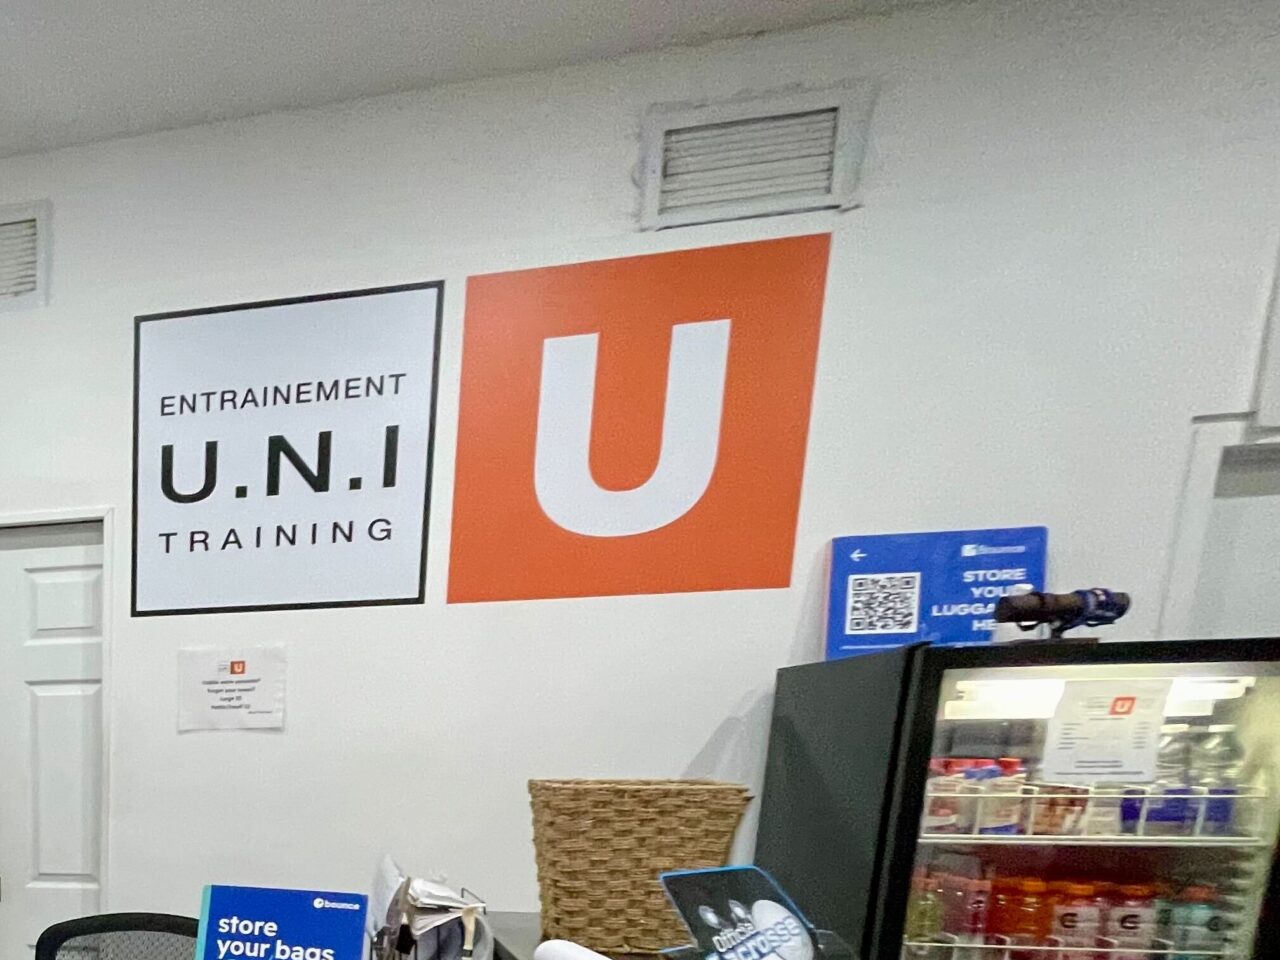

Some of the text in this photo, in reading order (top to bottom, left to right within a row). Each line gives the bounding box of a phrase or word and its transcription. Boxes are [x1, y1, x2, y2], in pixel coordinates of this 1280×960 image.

[160, 373, 407, 417] ENTRAINEMENT
[534, 318, 732, 538] U
[160, 425, 400, 504] U.N.I
[159, 518, 394, 554] TRAINING
[963, 568, 1027, 582] STORE
[971, 586, 1019, 598] YOU
[931, 603, 995, 616] LUGGA
[972, 619, 997, 631] HE
[218, 915, 278, 937] store
[216, 938, 271, 960] your
